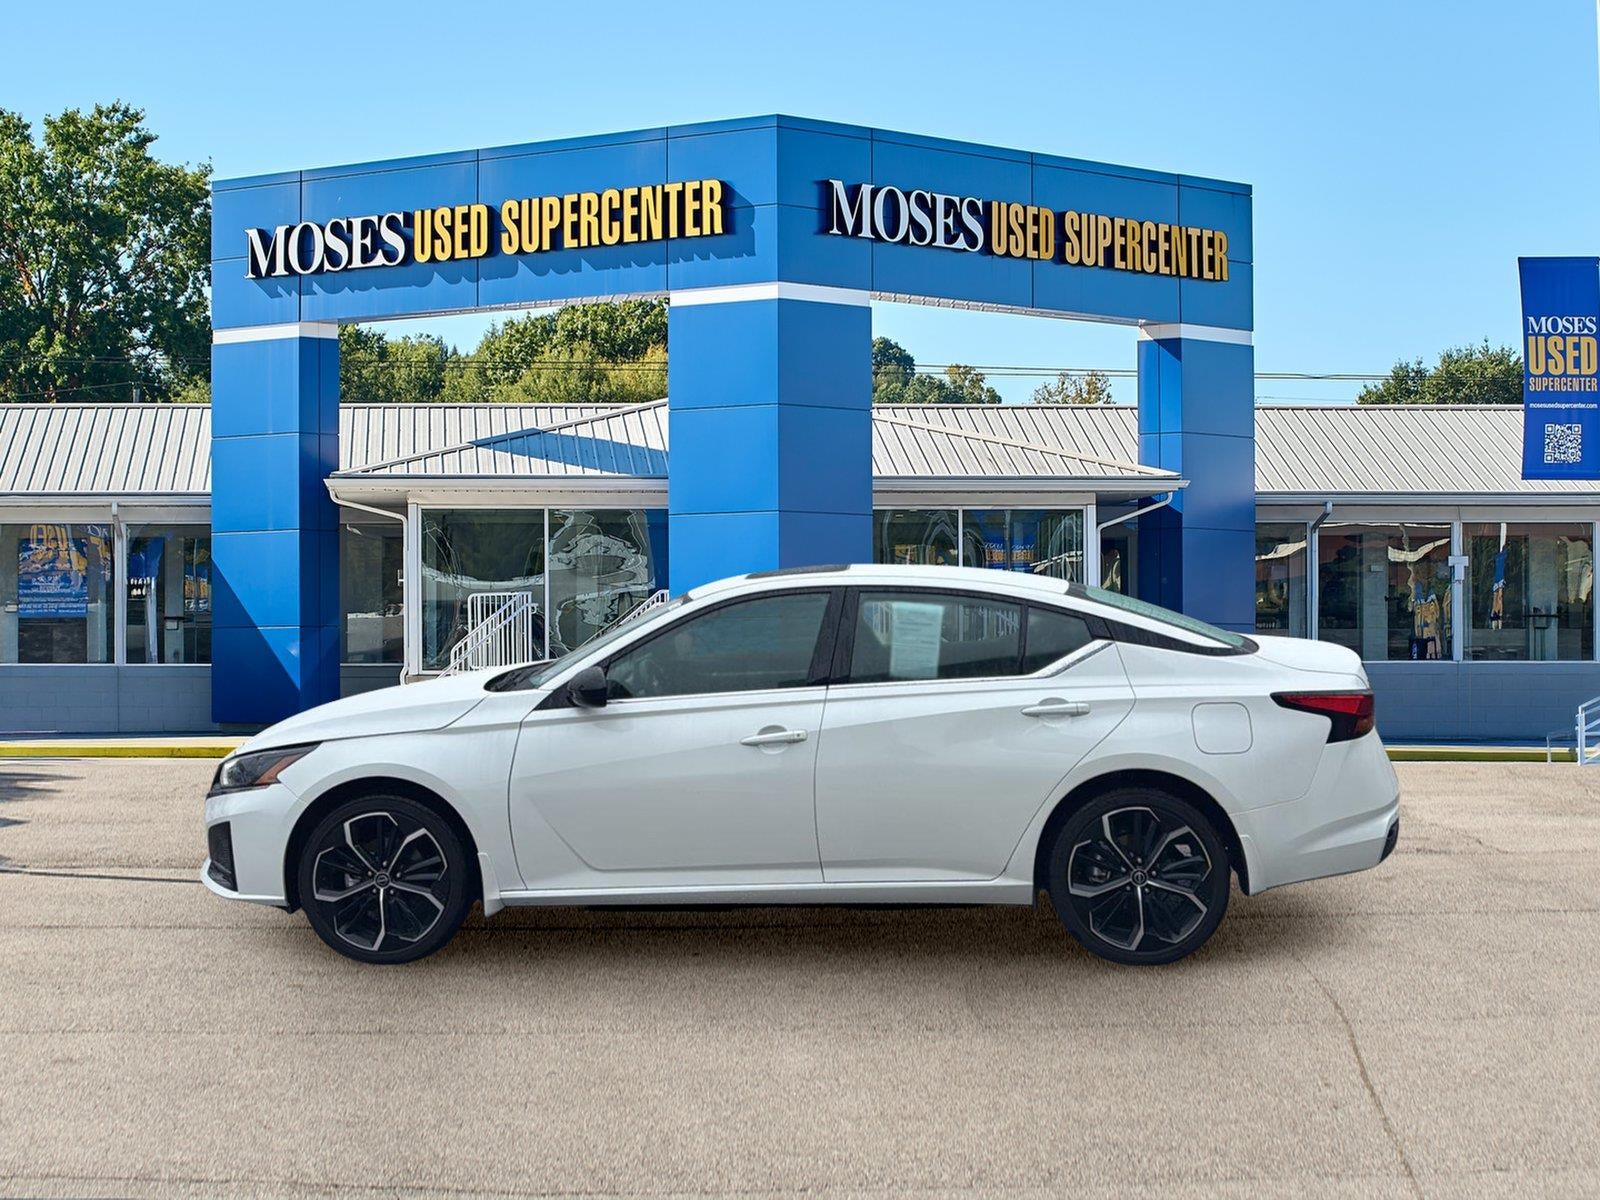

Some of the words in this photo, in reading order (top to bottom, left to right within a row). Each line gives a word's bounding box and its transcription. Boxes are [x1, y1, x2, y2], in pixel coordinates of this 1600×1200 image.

[244, 211, 408, 280] MOSES
[412, 203, 489, 264] USED
[500, 179, 724, 255] SUPERCENTER
[827, 179, 985, 252] MOSES
[990, 200, 1055, 260] USED
[1064, 210, 1229, 281] SUPERCENTER
[1527, 316, 1597, 334] MOSES
[1528, 335, 1598, 375] USED
[1529, 377, 1598, 392] SUPERCENTER
